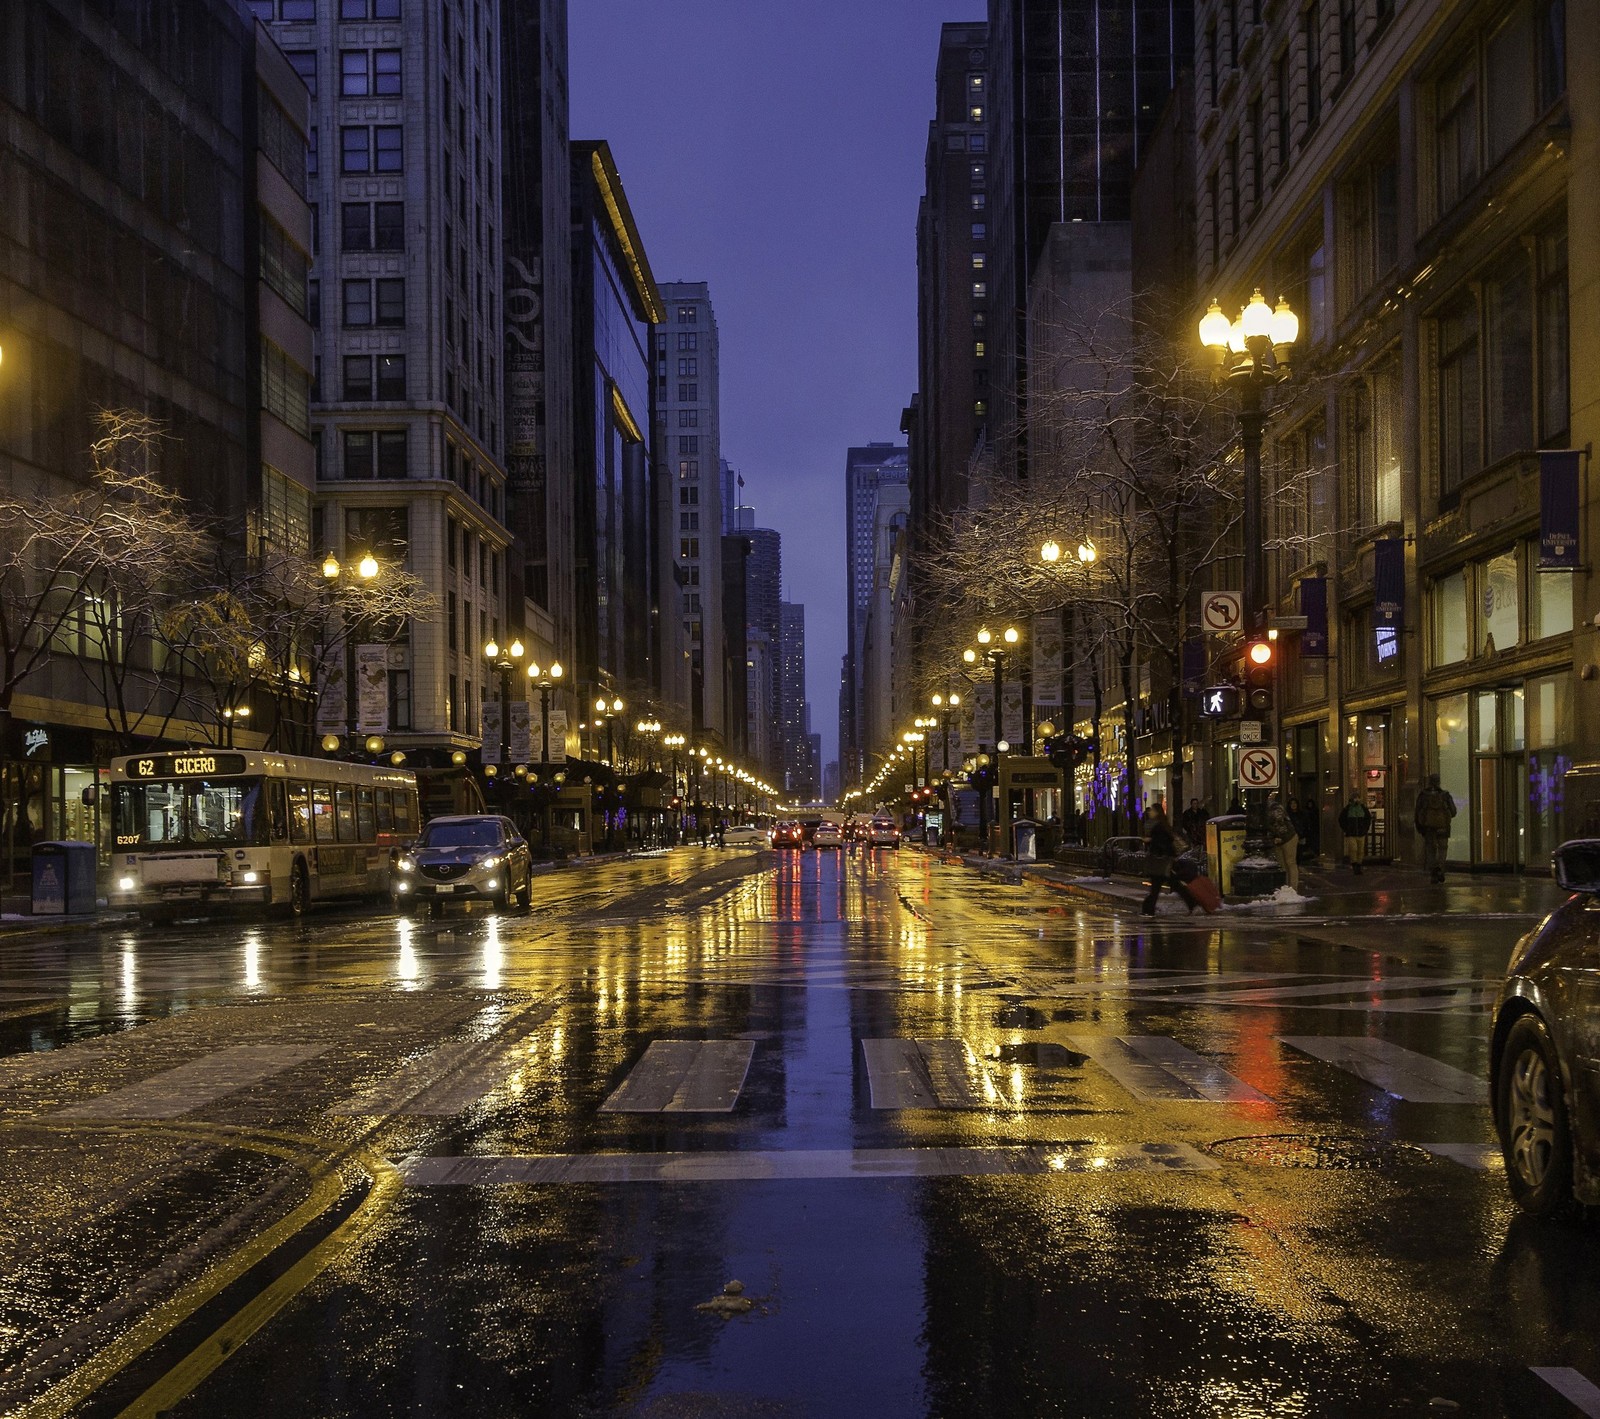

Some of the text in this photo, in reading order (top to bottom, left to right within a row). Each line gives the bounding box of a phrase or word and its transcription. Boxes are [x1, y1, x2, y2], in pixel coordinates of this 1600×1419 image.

[504, 256, 542, 352] 202
[513, 353, 542, 362] STATE
[138, 757, 216, 775] 62 CICERO
[116, 834, 140, 845] 6207
